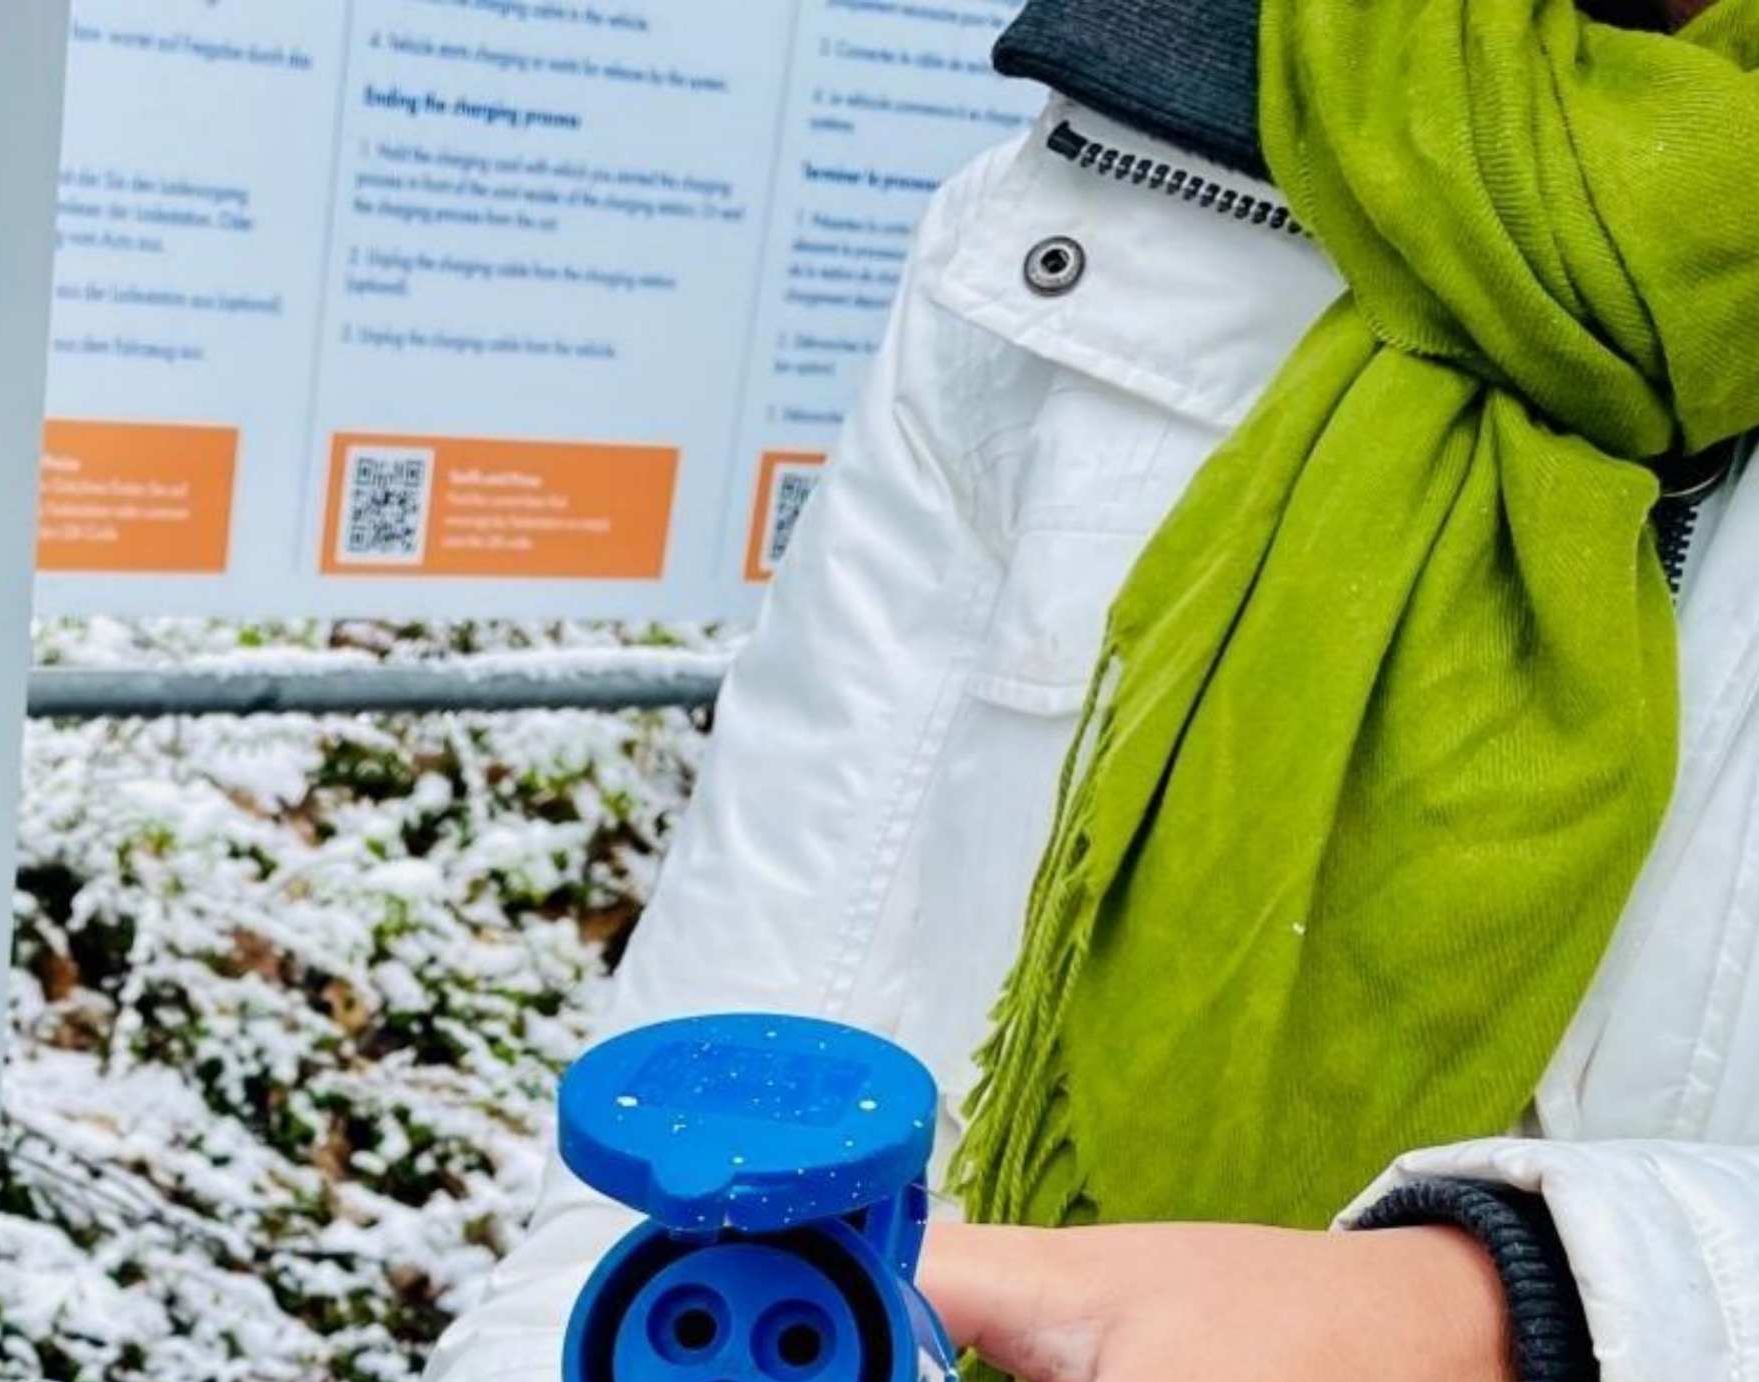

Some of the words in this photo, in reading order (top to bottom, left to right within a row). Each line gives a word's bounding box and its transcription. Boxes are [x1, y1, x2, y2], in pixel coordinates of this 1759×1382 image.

[363, 85, 418, 114] Ending
[424, 94, 446, 114] the
[453, 98, 518, 127] charging
